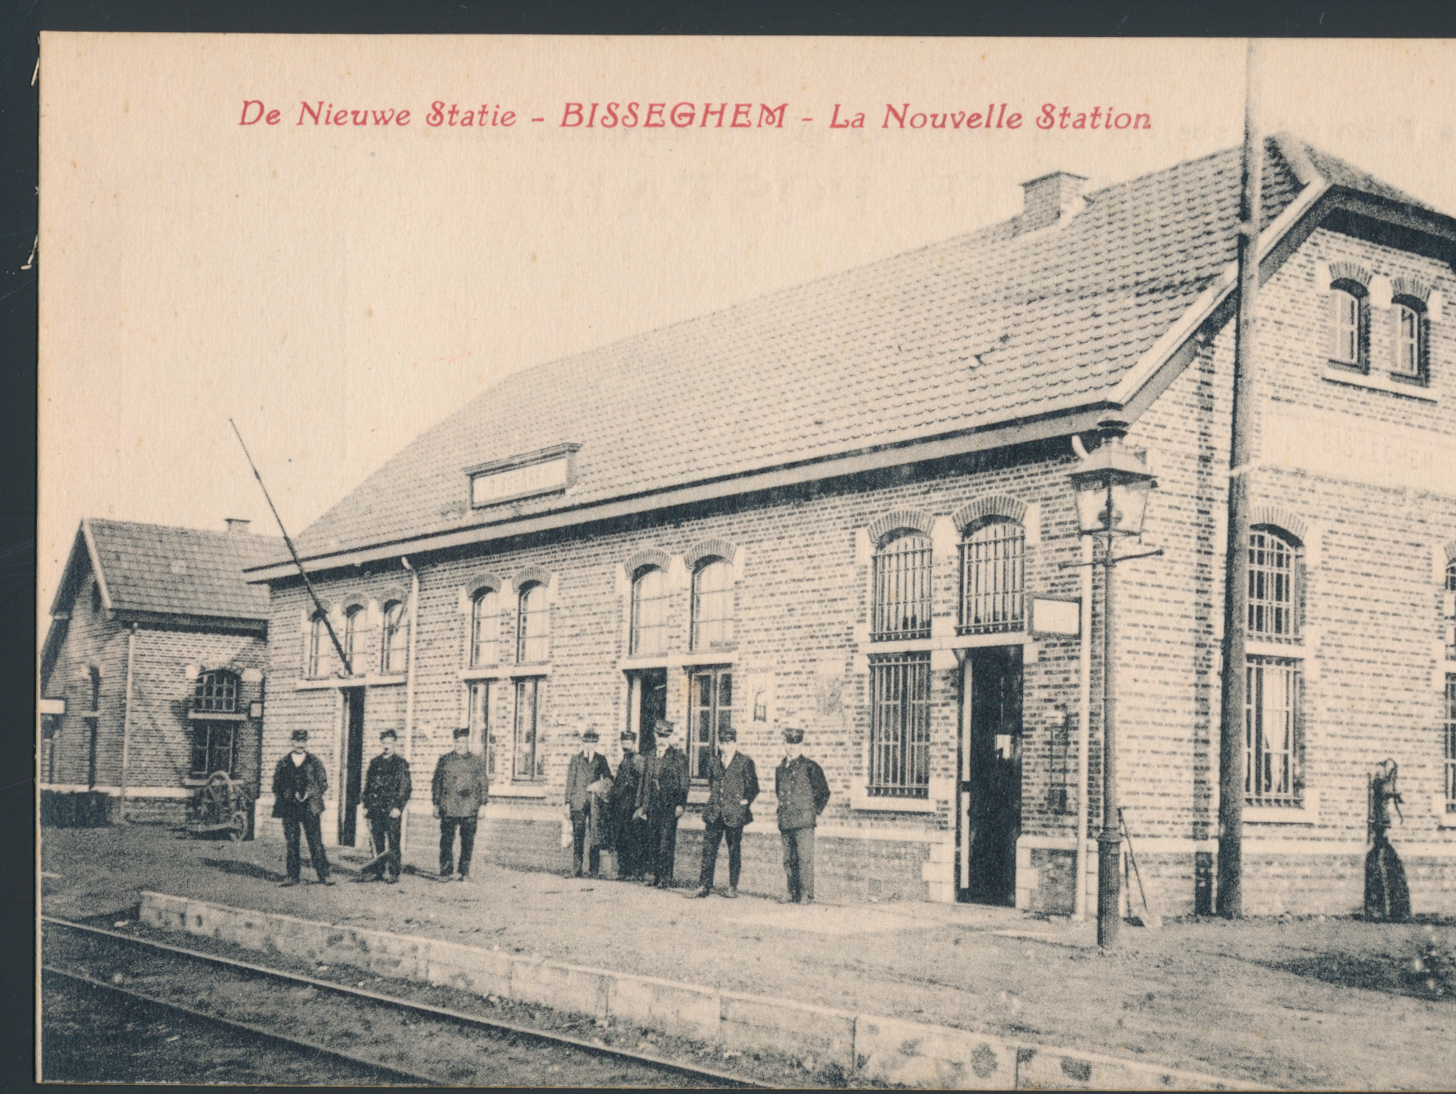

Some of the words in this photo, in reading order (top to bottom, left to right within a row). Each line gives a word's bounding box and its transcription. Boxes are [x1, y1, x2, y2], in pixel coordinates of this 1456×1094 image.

[238, 99, 281, 126] De
[295, 100, 411, 127] Nieuwe
[425, 100, 517, 128] Statie
[558, 101, 789, 129] BISSEGHEM
[828, 103, 866, 129] La
[881, 102, 1023, 130] Nouvelle
[1035, 102, 1152, 130] Station
